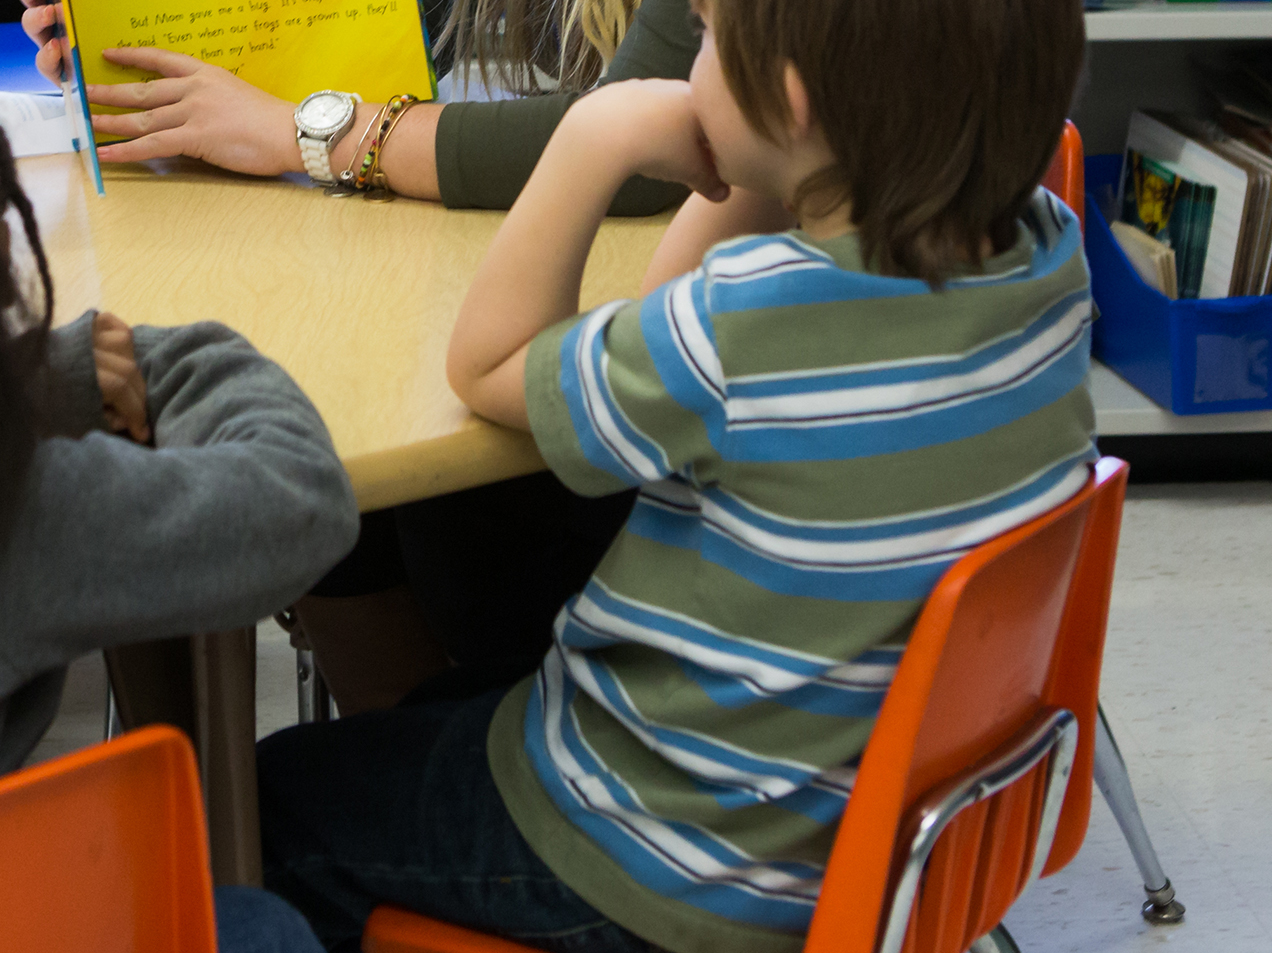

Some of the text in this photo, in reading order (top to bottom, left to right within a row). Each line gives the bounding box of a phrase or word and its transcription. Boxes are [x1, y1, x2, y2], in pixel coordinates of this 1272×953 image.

[130, 16, 149, 29] But
[155, 13, 184, 26] Mom
[189, 9, 213, 24] gave
[218, 7, 232, 16] me
[237, 5, 244, 13] a
[163, 32, 193, 44] "Even
[198, 27, 224, 39] when
[229, 24, 248, 34] our
[254, 19, 280, 33] frogs
[285, 17, 302, 27] are
[306, 11, 340, 28] grown
[367, 0, 398, 16] they'll
[200, 48, 223, 60] than
[229, 45, 244, 57] my
